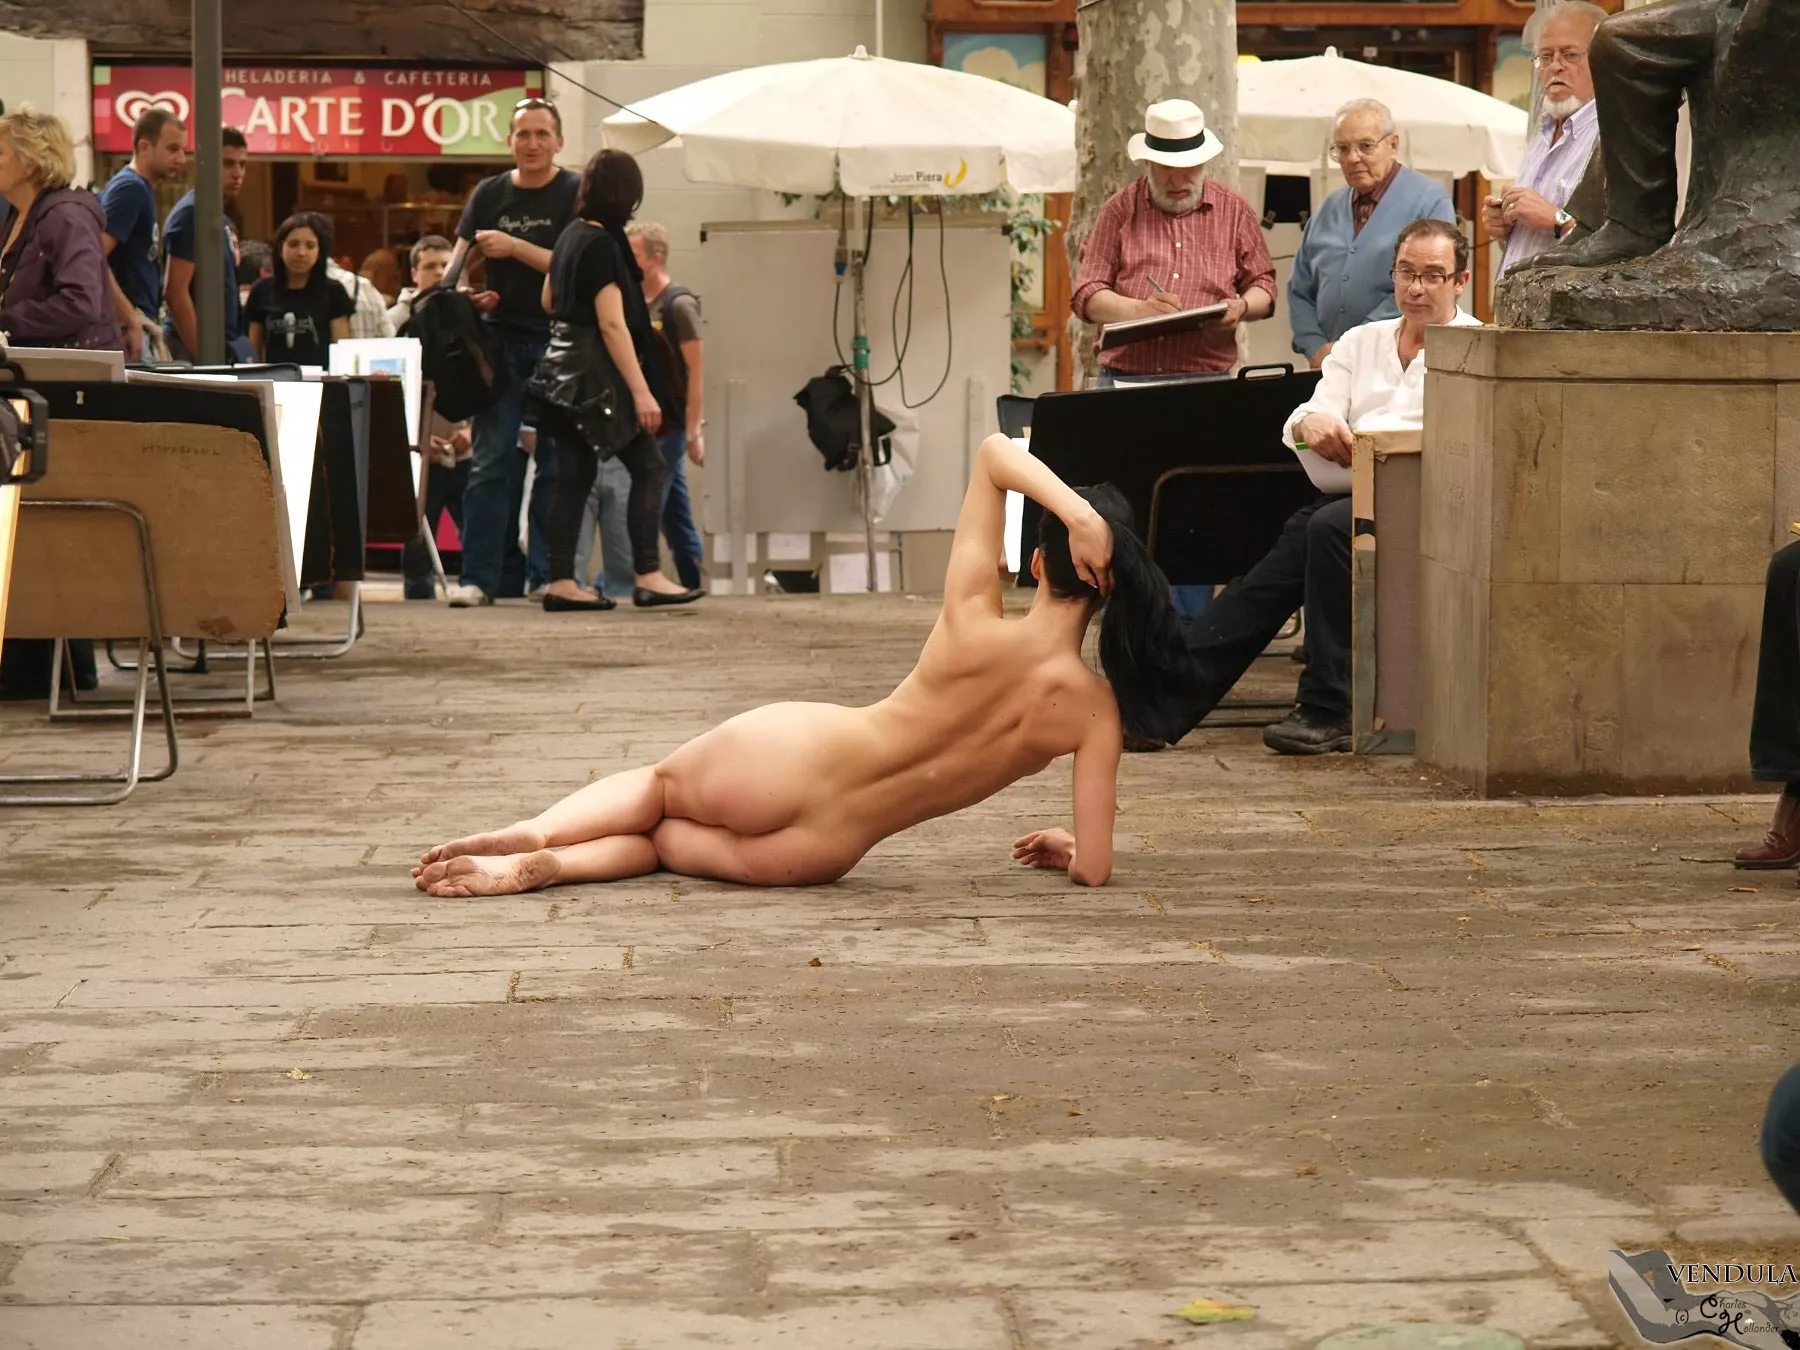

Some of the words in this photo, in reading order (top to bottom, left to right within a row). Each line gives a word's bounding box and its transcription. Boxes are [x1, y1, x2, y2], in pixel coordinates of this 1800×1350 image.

[224, 69, 333, 84] HELADERIA
[353, 71, 366, 85] &
[383, 71, 492, 86] CAFETERIA
[916, 171, 942, 183] Piera
